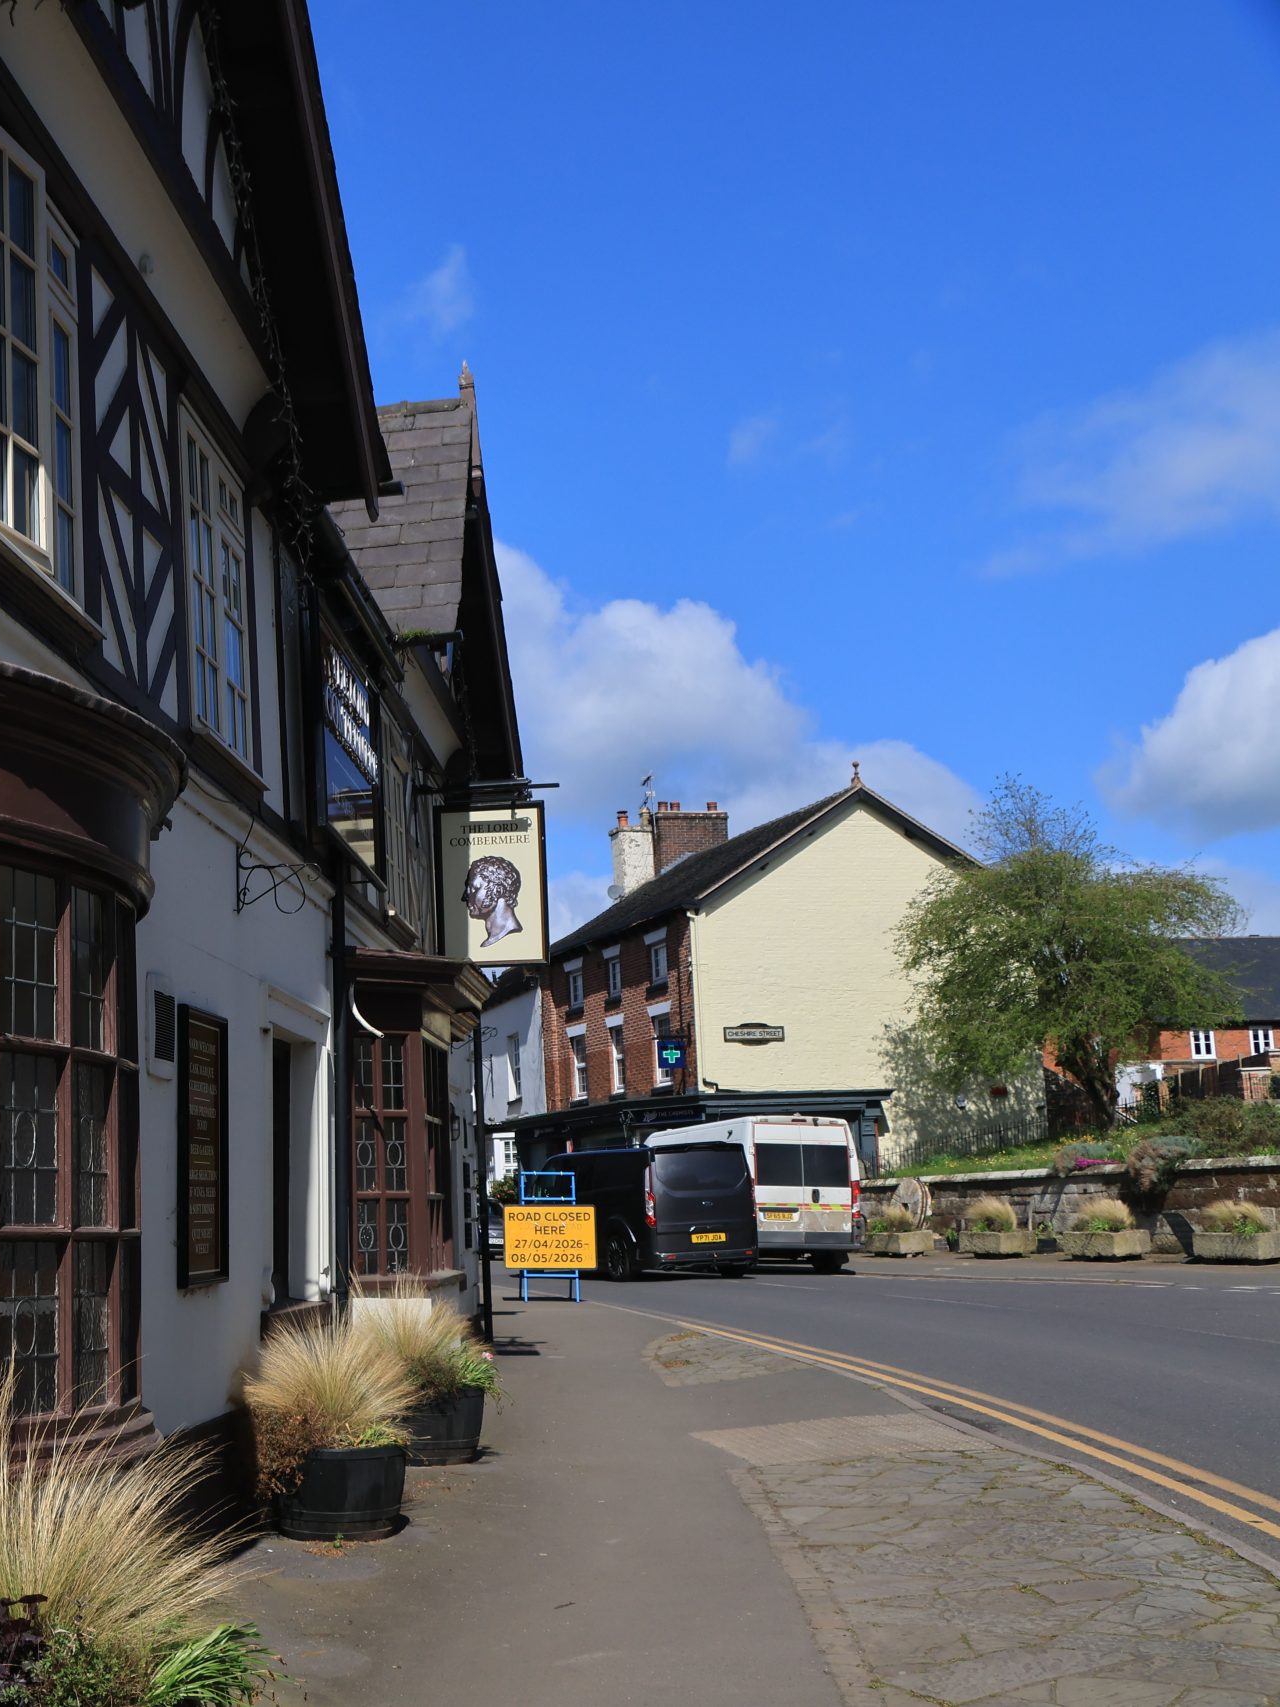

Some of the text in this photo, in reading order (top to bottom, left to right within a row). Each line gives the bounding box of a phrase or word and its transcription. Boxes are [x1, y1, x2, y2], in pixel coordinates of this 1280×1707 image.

[460, 823, 518, 834] THE LORD
[450, 835, 529, 847] COMBERMERE
[508, 1212, 590, 1221] ROAD CLOSED
[535, 1226, 566, 1235] HERE
[515, 1240, 589, 1248] 27/04/2026-
[512, 1254, 582, 1262] 08/05/2026
